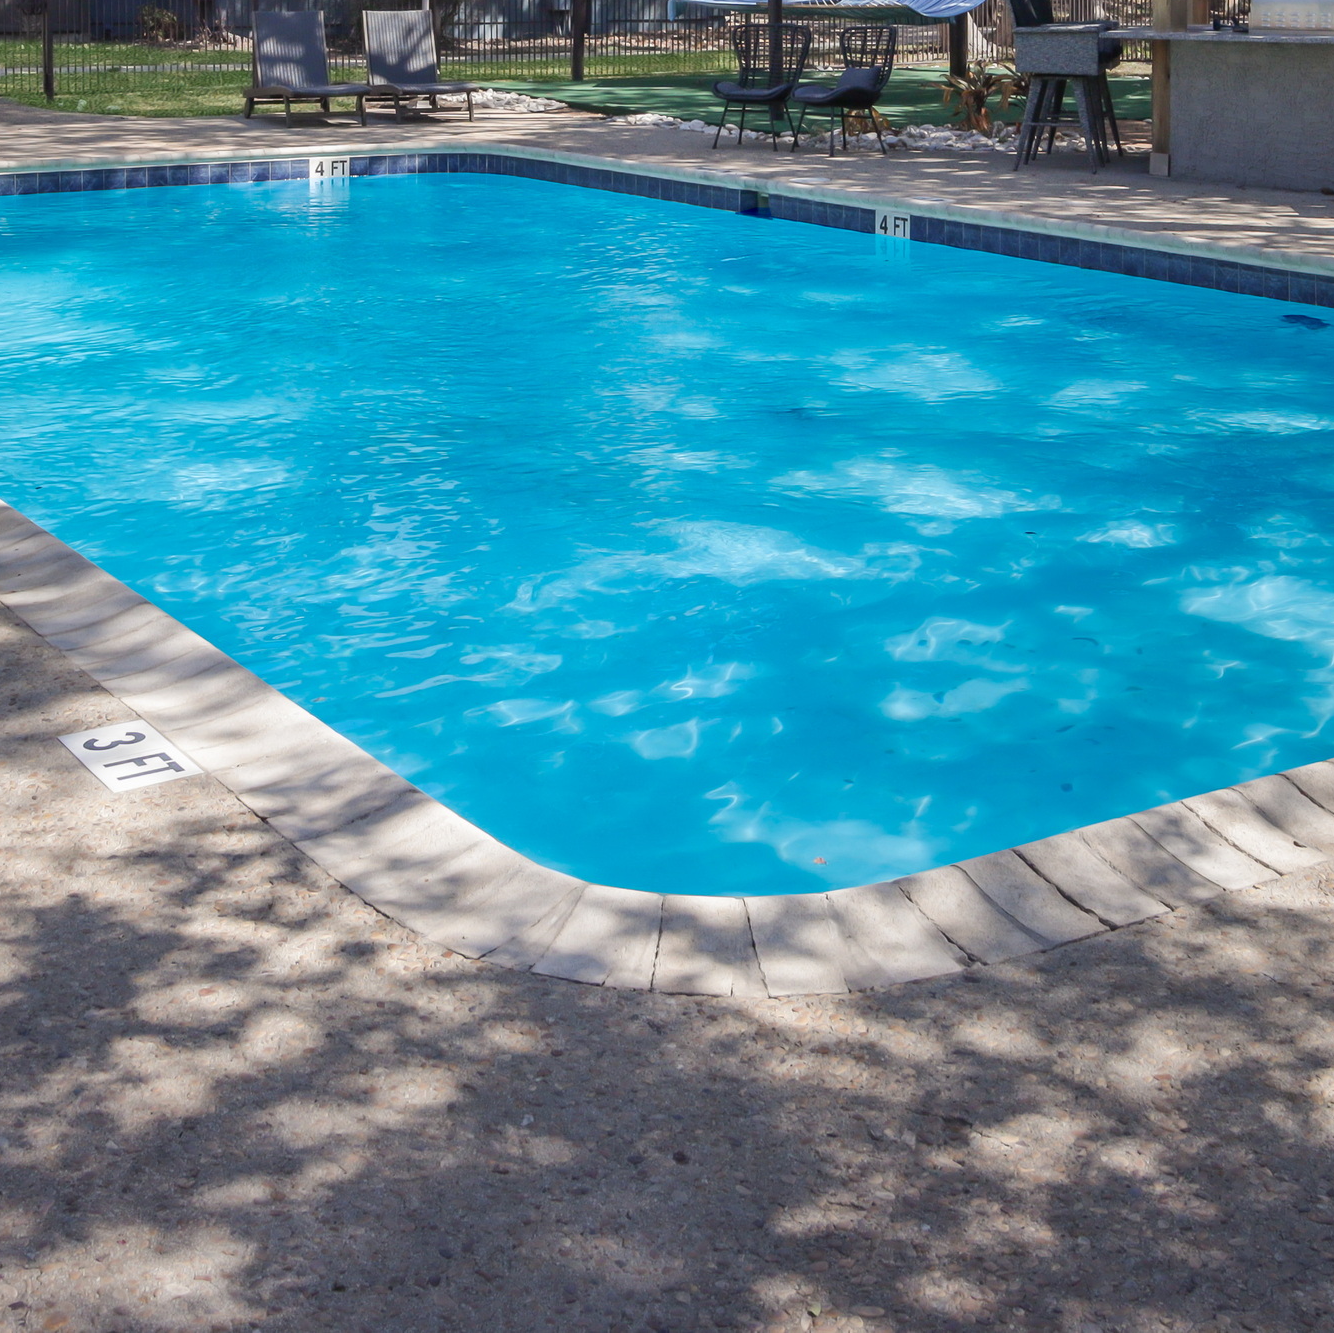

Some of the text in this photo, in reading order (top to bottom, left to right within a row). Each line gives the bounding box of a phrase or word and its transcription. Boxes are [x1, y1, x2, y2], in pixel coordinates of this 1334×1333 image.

[315, 160, 347, 176] 4 FT
[879, 215, 908, 237] 4 FT
[83, 732, 185, 780] 3 FT
